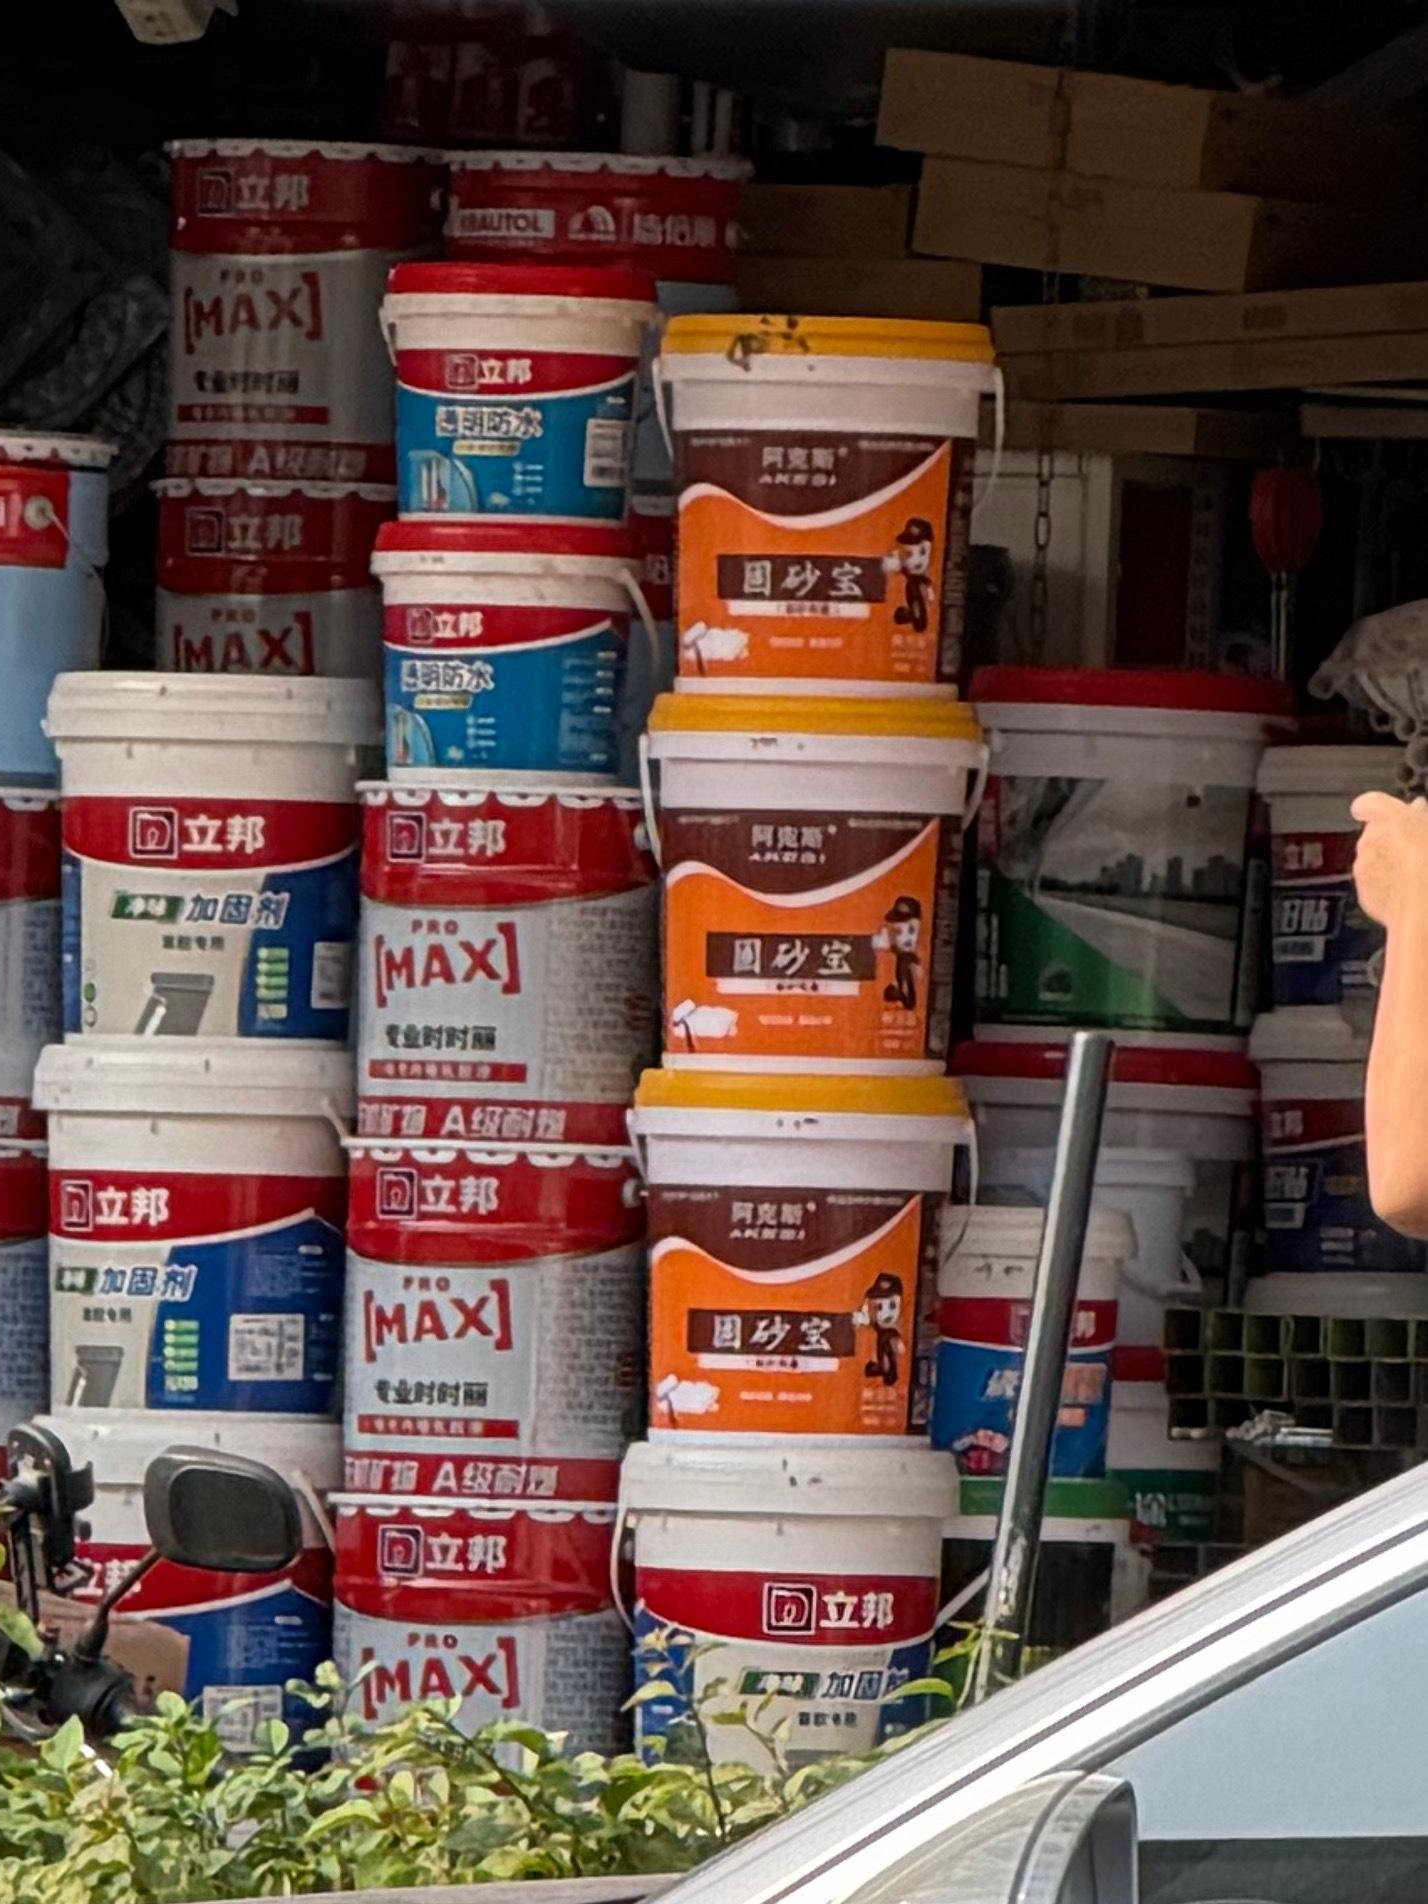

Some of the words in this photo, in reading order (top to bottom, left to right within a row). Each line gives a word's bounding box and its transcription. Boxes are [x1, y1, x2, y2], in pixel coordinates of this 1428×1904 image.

[478, 357, 533, 385] 立邦
[433, 610, 484, 639] 立邦
[181, 814, 266, 854] 立邦
[427, 818, 508, 857] 立邦
[186, 891, 291, 929] 加固剂
[410, 918, 460, 936] PRO
[95, 1186, 171, 1227] 立邦
[420, 1175, 500, 1216] 立邦
[98, 1265, 198, 1302] 加固剂
[402, 1275, 451, 1292] PRO
[425, 1531, 508, 1574] 立邦
[818, 1590, 895, 1631] 立邦
[407, 1632, 459, 1650] PRO
